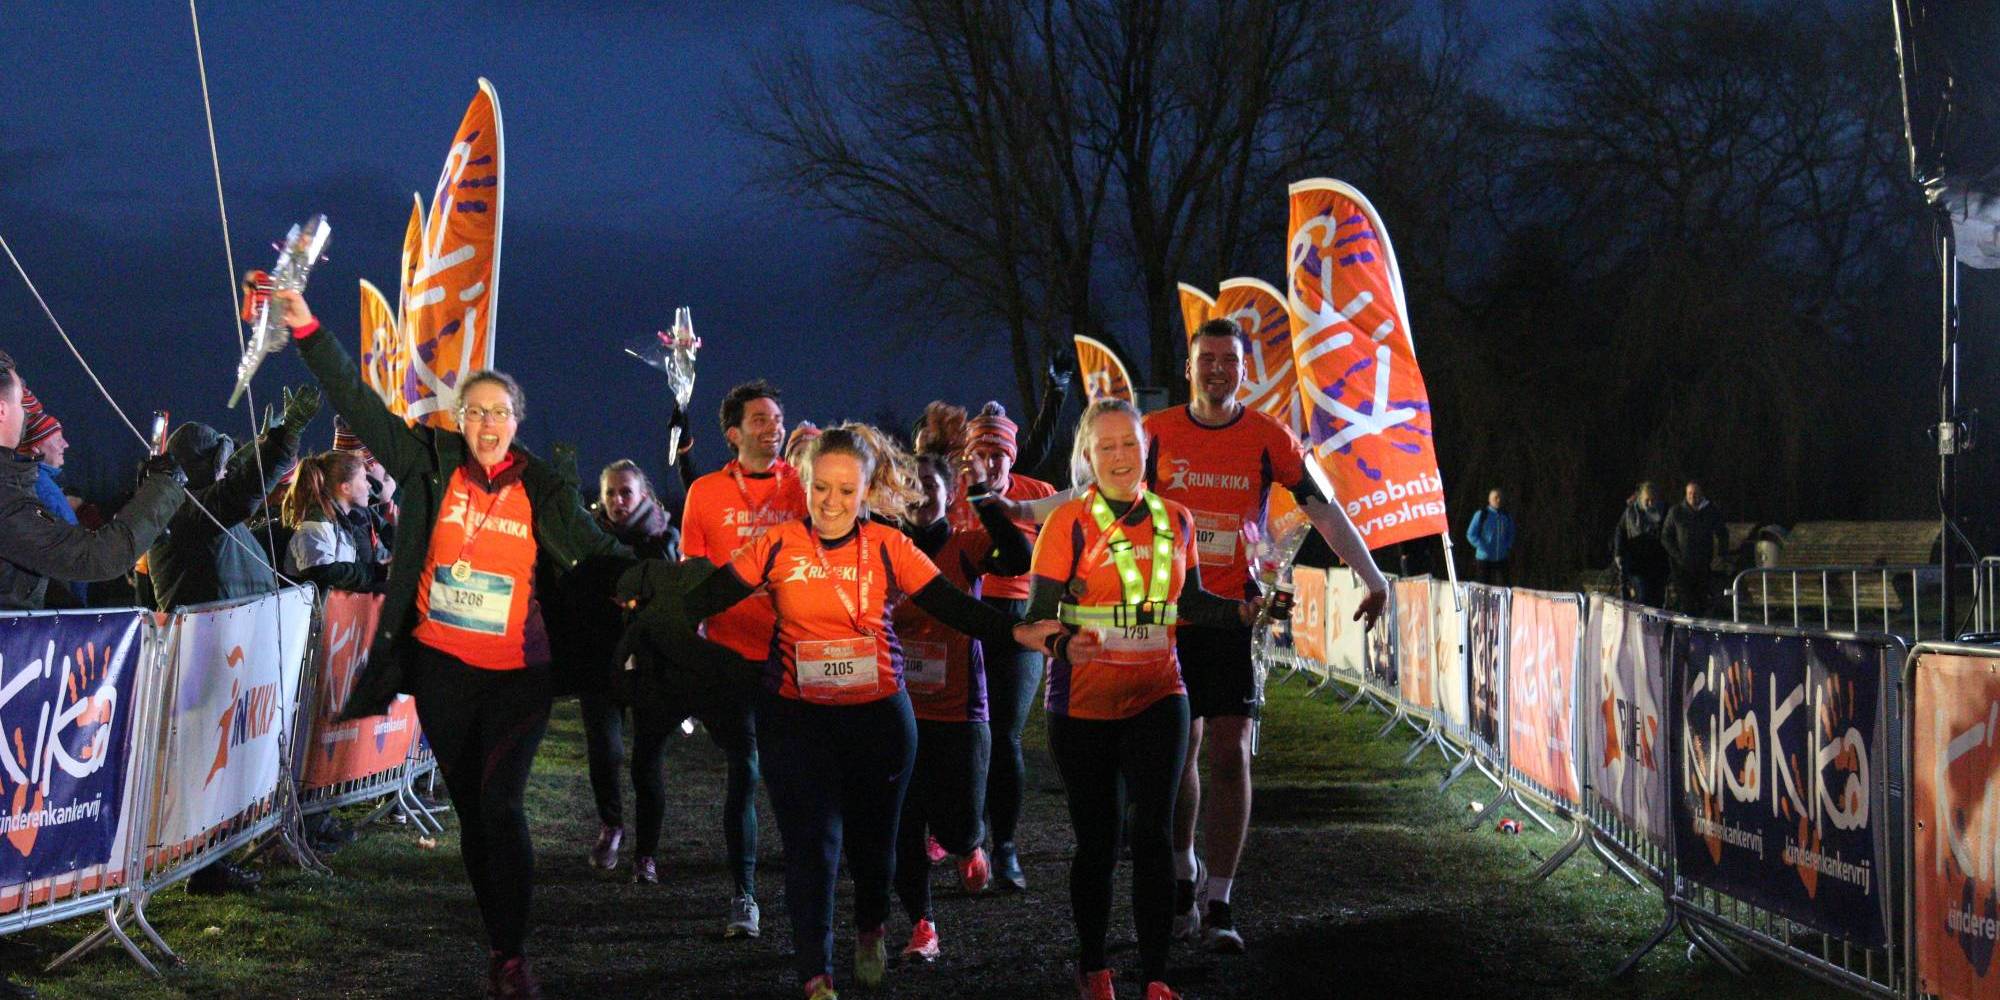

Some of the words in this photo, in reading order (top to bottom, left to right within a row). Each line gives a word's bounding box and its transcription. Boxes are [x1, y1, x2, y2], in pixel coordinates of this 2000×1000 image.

[1188, 471, 1214, 488] RUN
[1221, 474, 1249, 491] KIKA
[499, 517, 528, 540] KIKA
[1196, 530, 1215, 543] 107
[808, 565, 831, 579] RU
[454, 590, 484, 608] 1208
[1123, 626, 1149, 640] 1791
[824, 661, 854, 676] 2105
[1786, 836, 1870, 896] kinderenkankervrij
